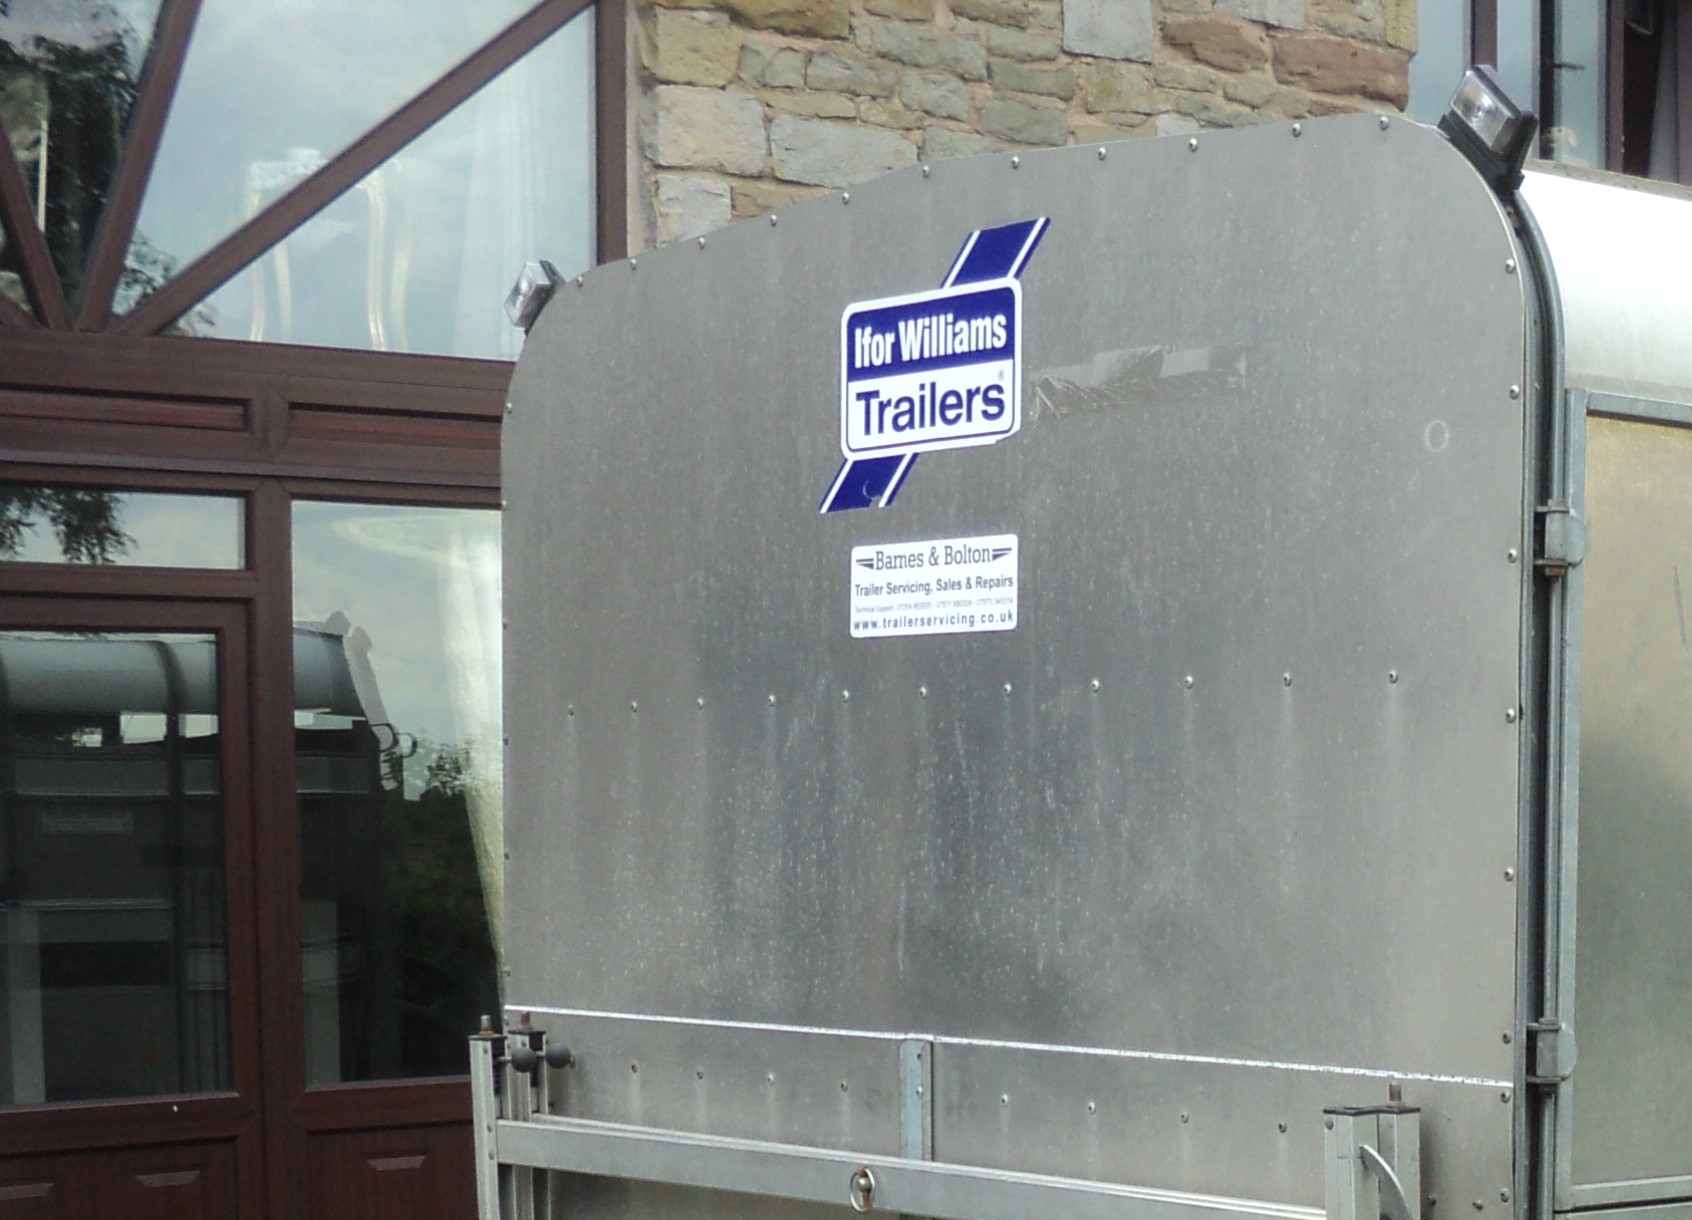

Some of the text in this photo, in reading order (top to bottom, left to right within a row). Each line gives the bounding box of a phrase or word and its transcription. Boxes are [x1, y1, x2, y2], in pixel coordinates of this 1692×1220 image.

[854, 313, 1007, 369] Ifor Williams
[855, 381, 1006, 436] Trailers
[875, 544, 992, 571] Barnes & Bolton
[855, 582, 884, 597] Trailer
[936, 577, 962, 592] Sales
[965, 576, 973, 590] &
[975, 574, 1014, 591] Repairs
[853, 609, 1014, 630] www.trailerservicing.co.uk
